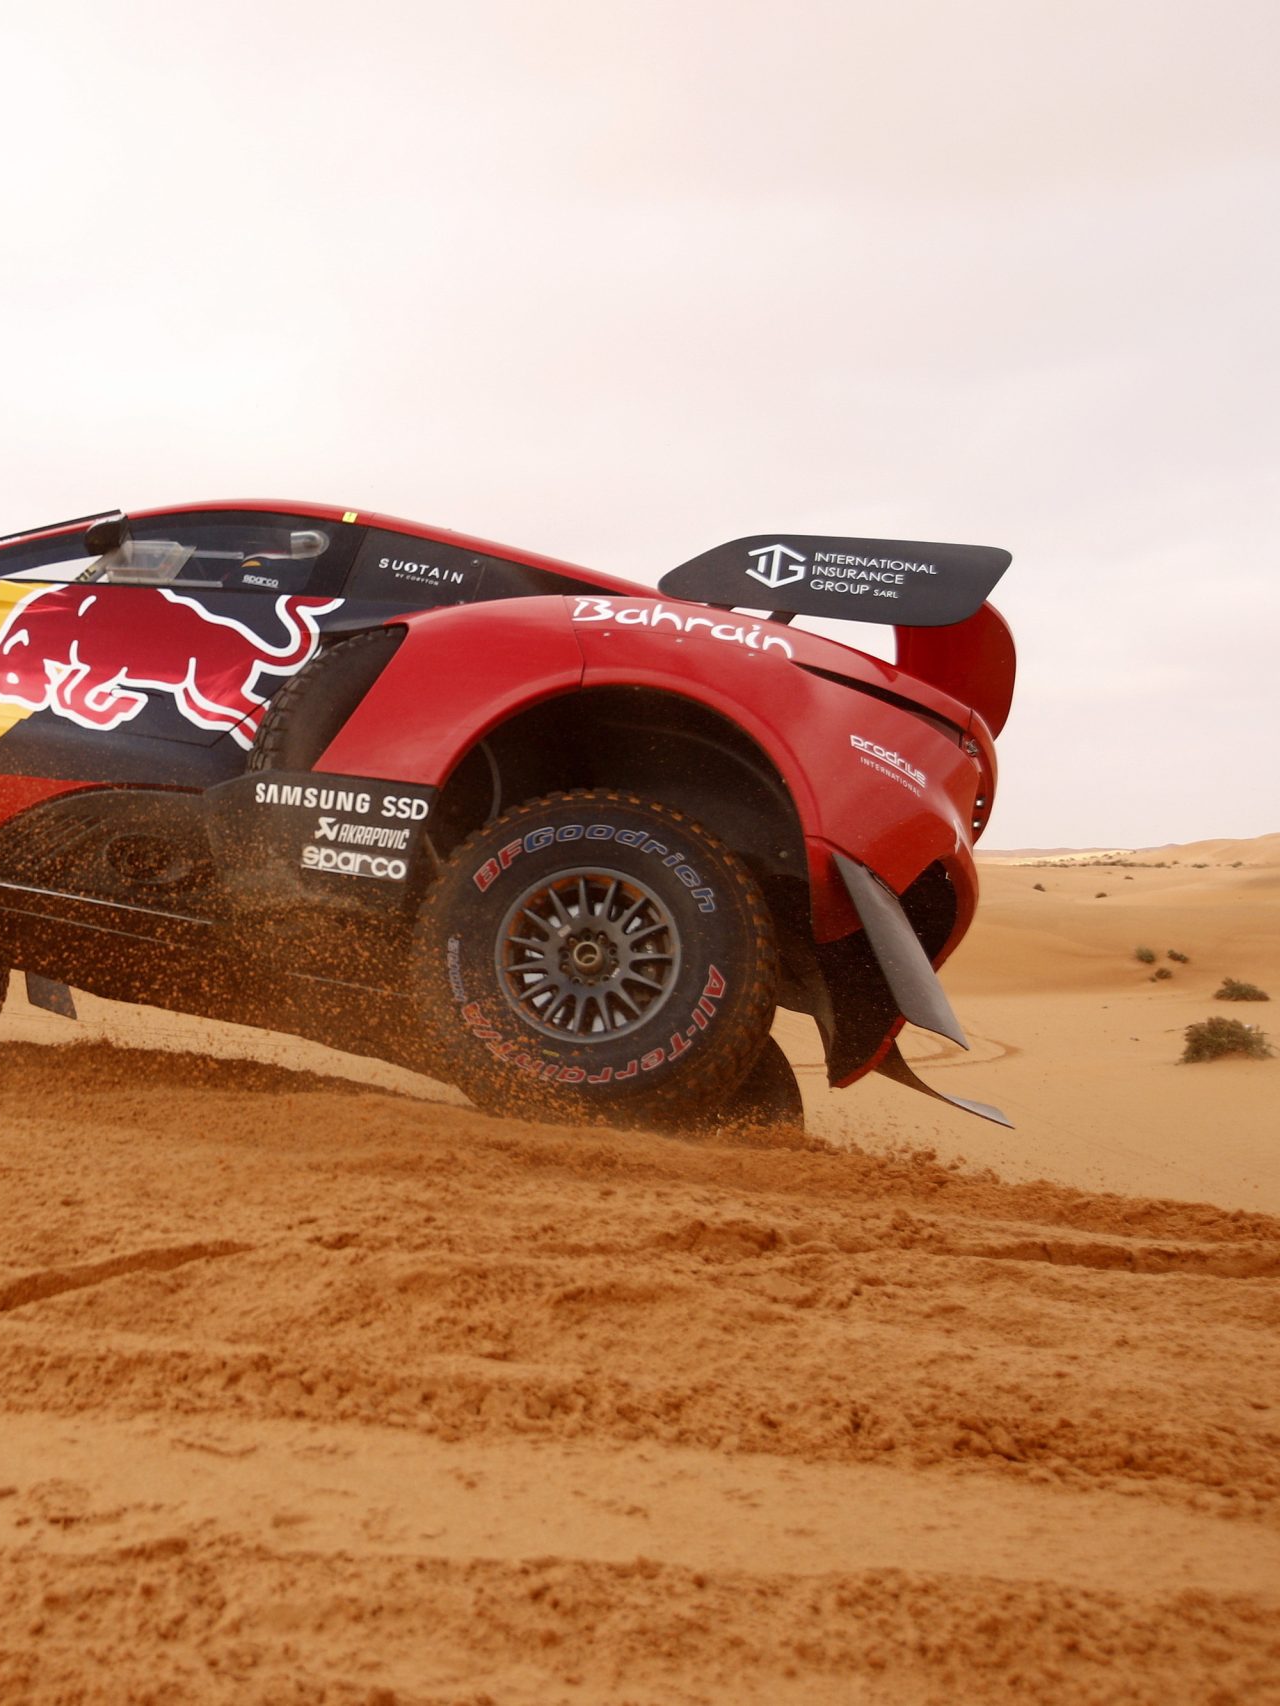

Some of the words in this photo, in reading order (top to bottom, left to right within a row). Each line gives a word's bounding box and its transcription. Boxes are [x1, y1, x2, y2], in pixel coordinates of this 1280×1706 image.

[811, 565, 905, 585] INSURANCE
[814, 552, 937, 575] INTERNATIONAL
[810, 579, 870, 595] GROUP
[873, 589, 898, 599] SARL
[572, 597, 794, 659] Bahrain
[860, 756, 921, 798] INTERNATIONAL
[255, 783, 371, 814] SAMSUNG
[381, 796, 429, 820] SSD
[301, 846, 407, 880] sparco
[473, 824, 716, 913] BFGoodrich
